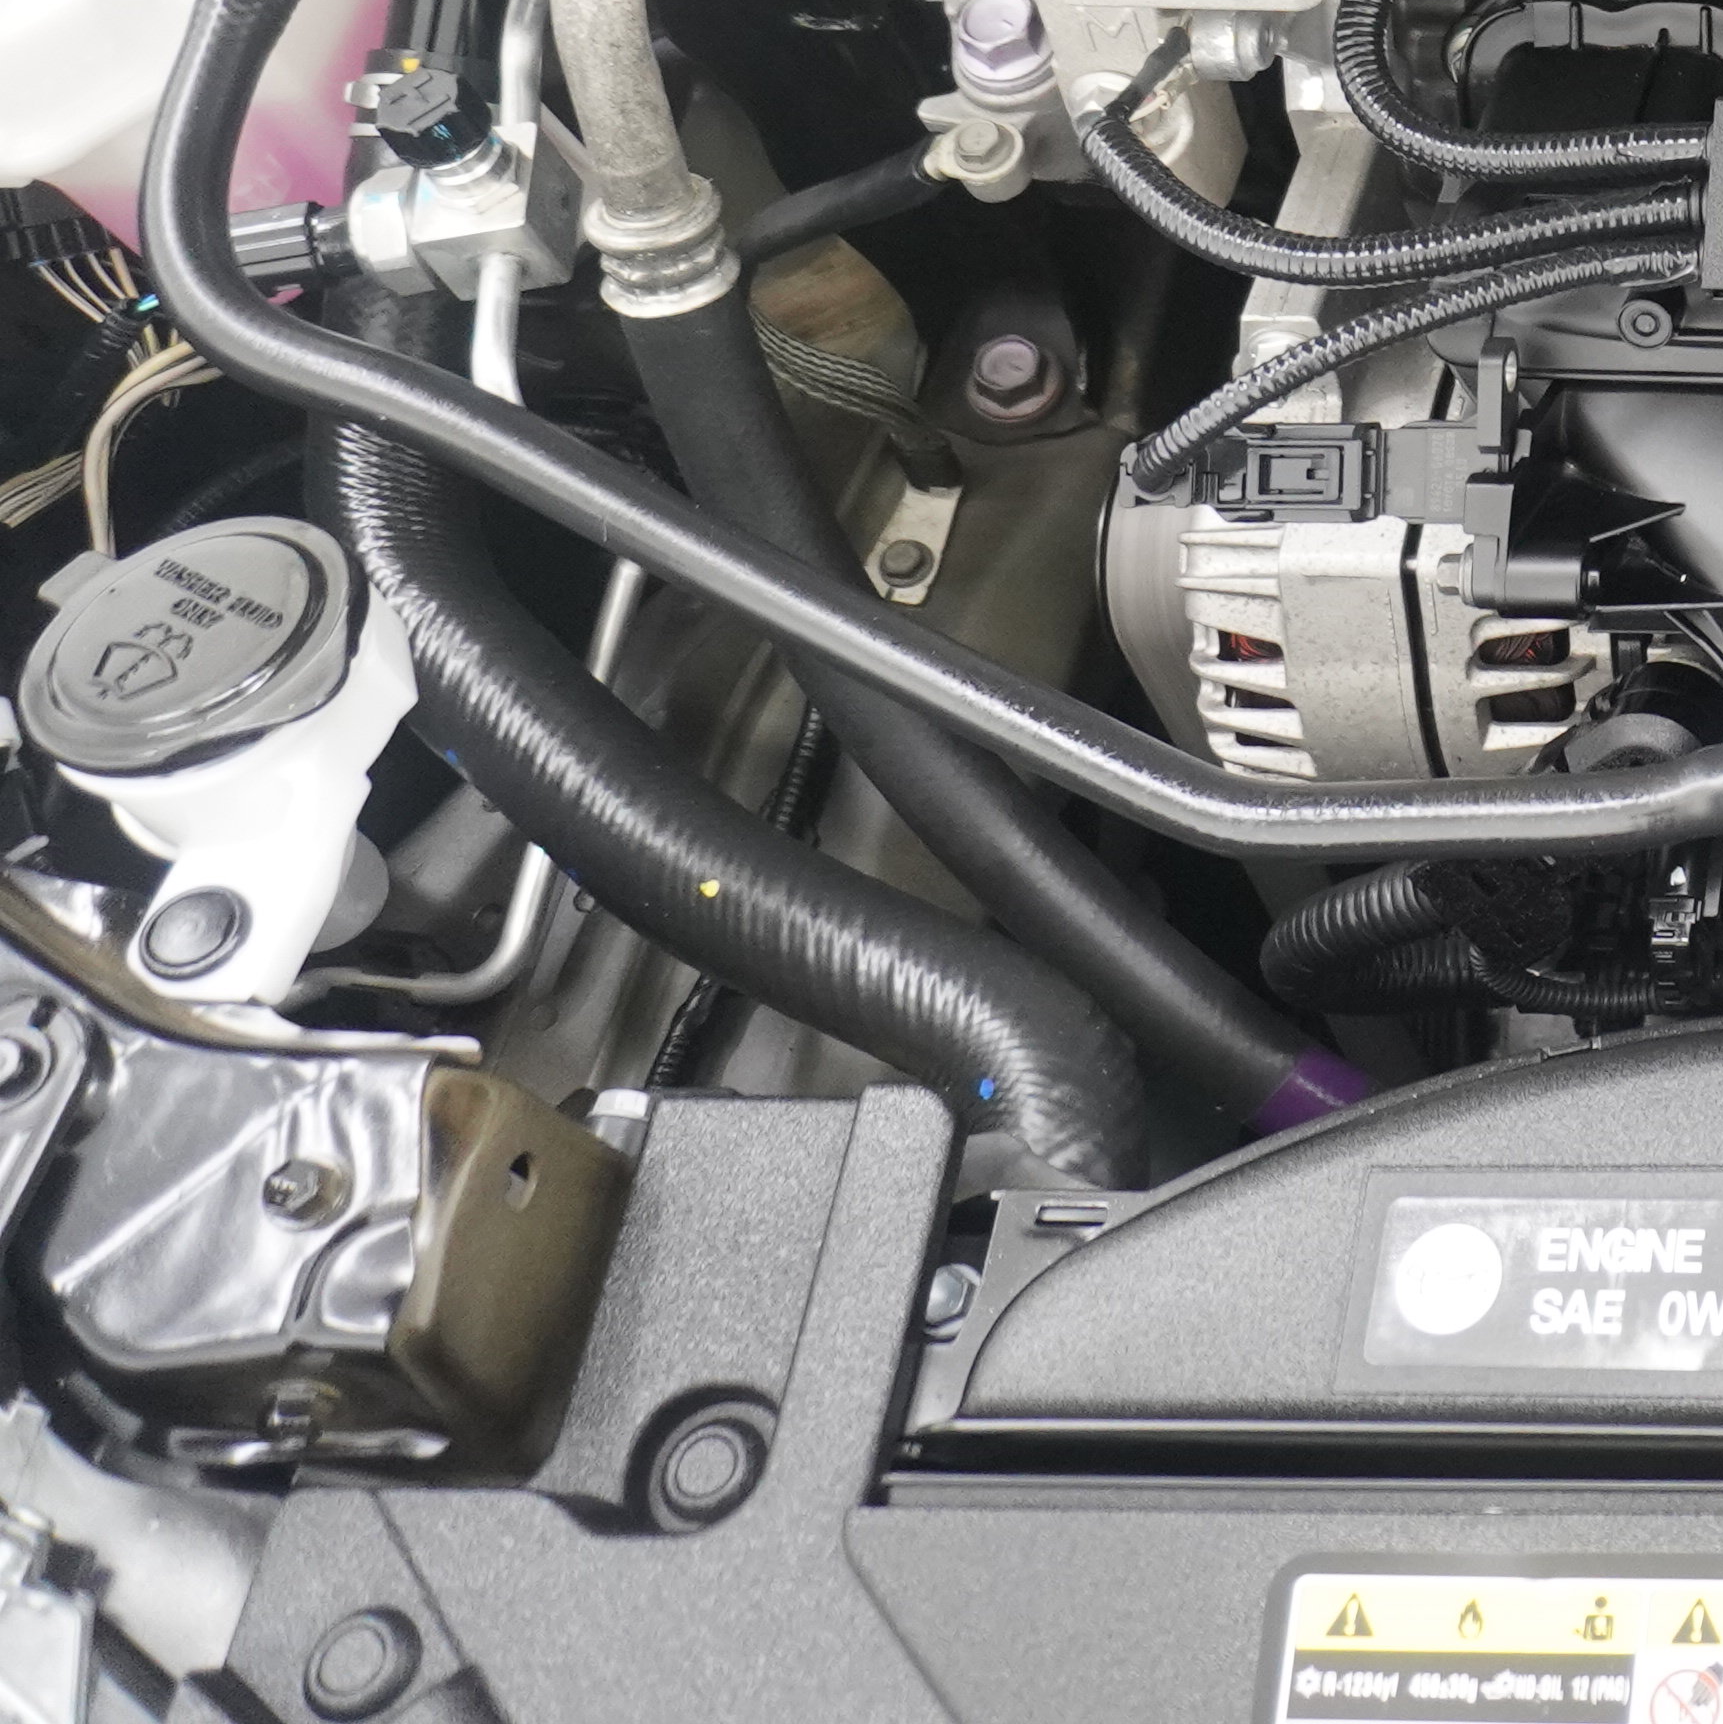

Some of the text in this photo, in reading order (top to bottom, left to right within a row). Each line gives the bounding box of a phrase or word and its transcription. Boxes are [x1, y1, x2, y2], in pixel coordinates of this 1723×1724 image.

[154, 558, 283, 628] WASHER FLUID
[170, 597, 224, 629] ONLY
[1537, 1227, 1706, 1273] ENGINE
[1529, 1287, 1626, 1335] SAE
